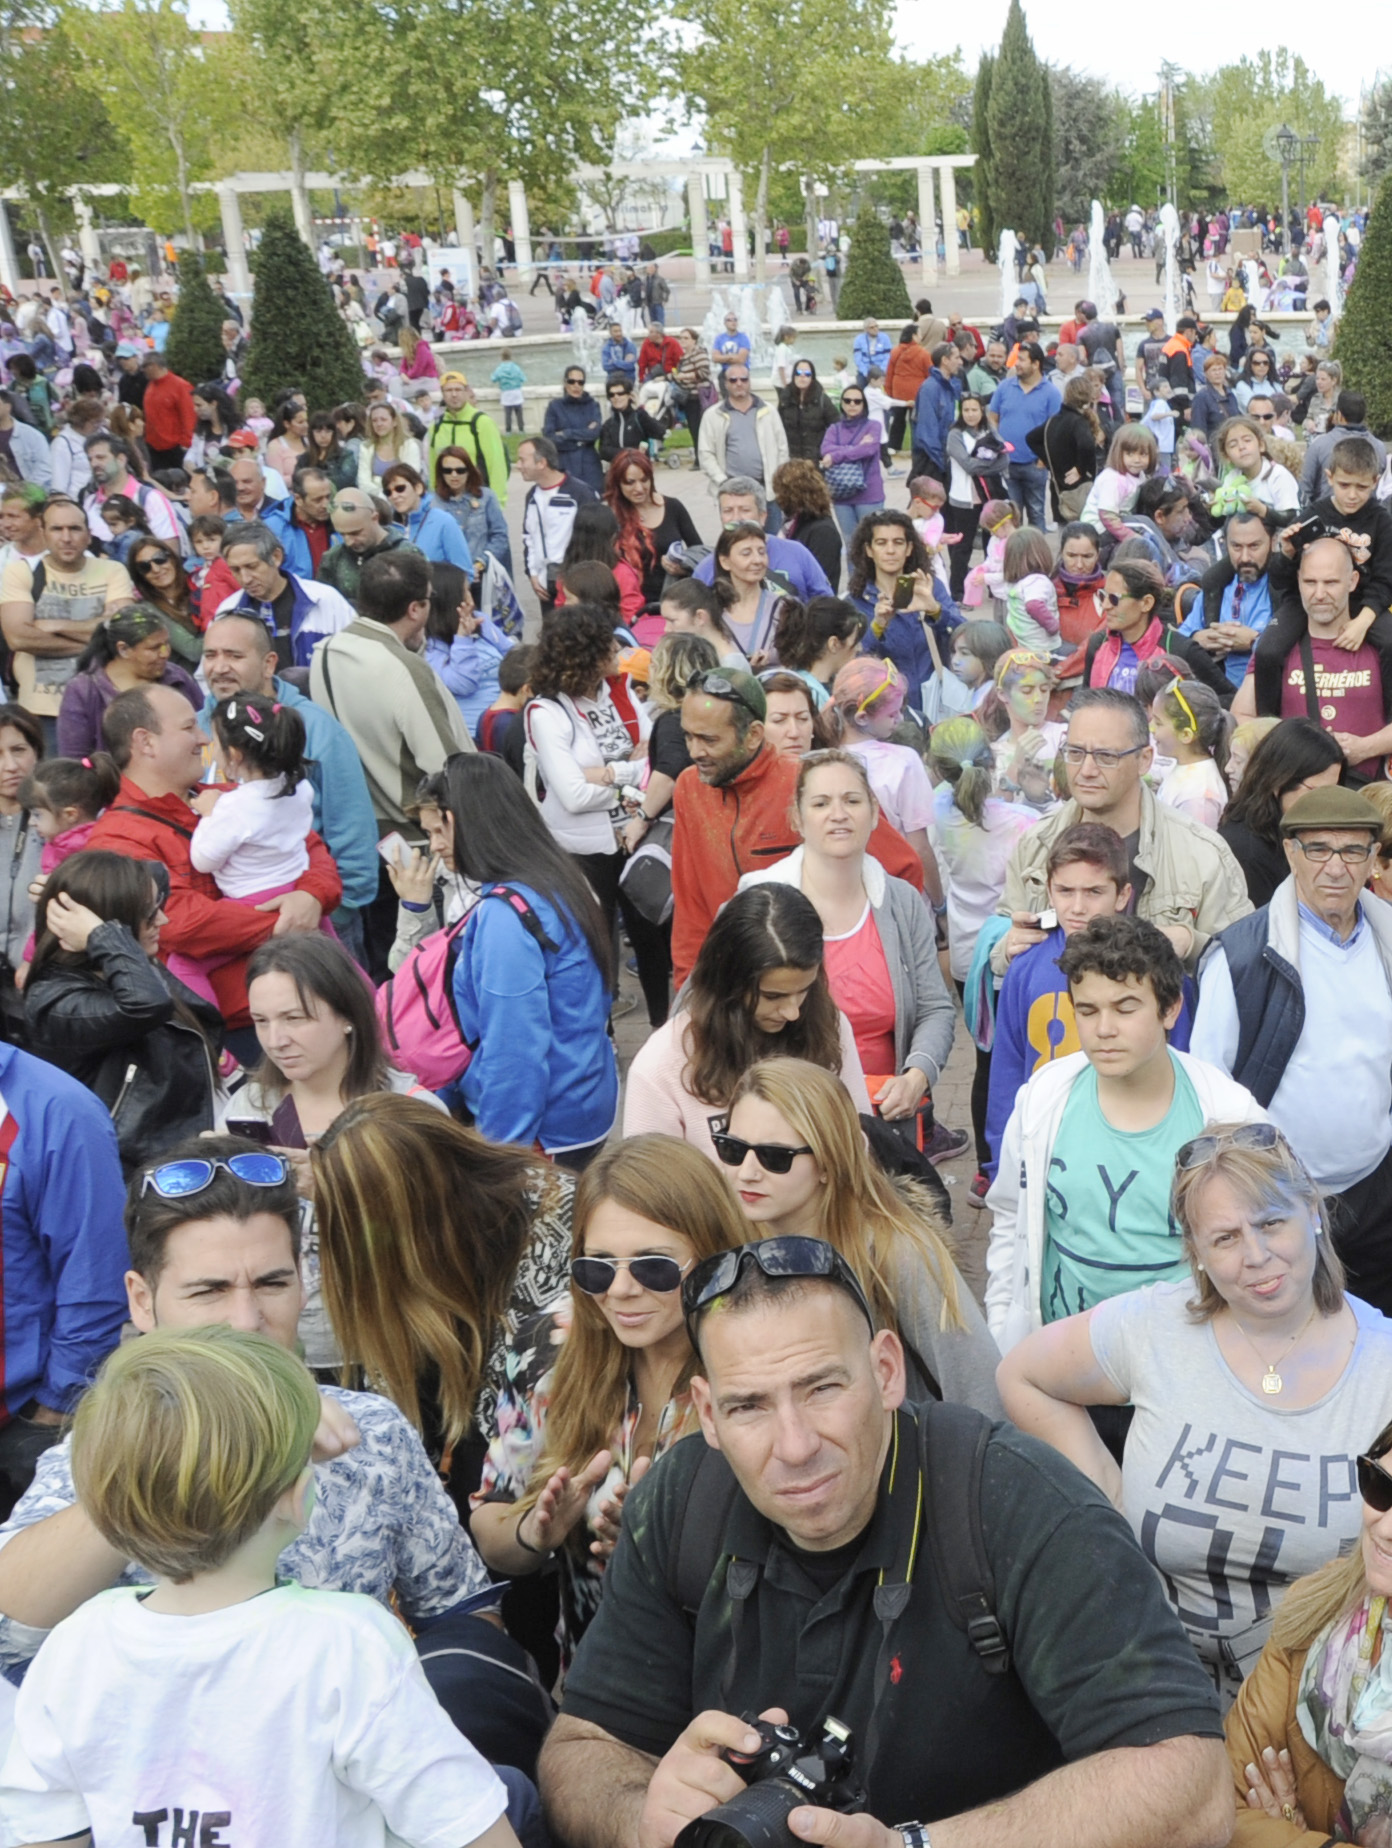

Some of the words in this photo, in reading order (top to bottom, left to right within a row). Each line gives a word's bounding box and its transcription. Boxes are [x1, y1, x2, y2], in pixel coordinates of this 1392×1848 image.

[1155, 1423, 1358, 1528] KEEP
[788, 1767, 816, 1790] Nikon
[132, 1807, 231, 1848] THE
